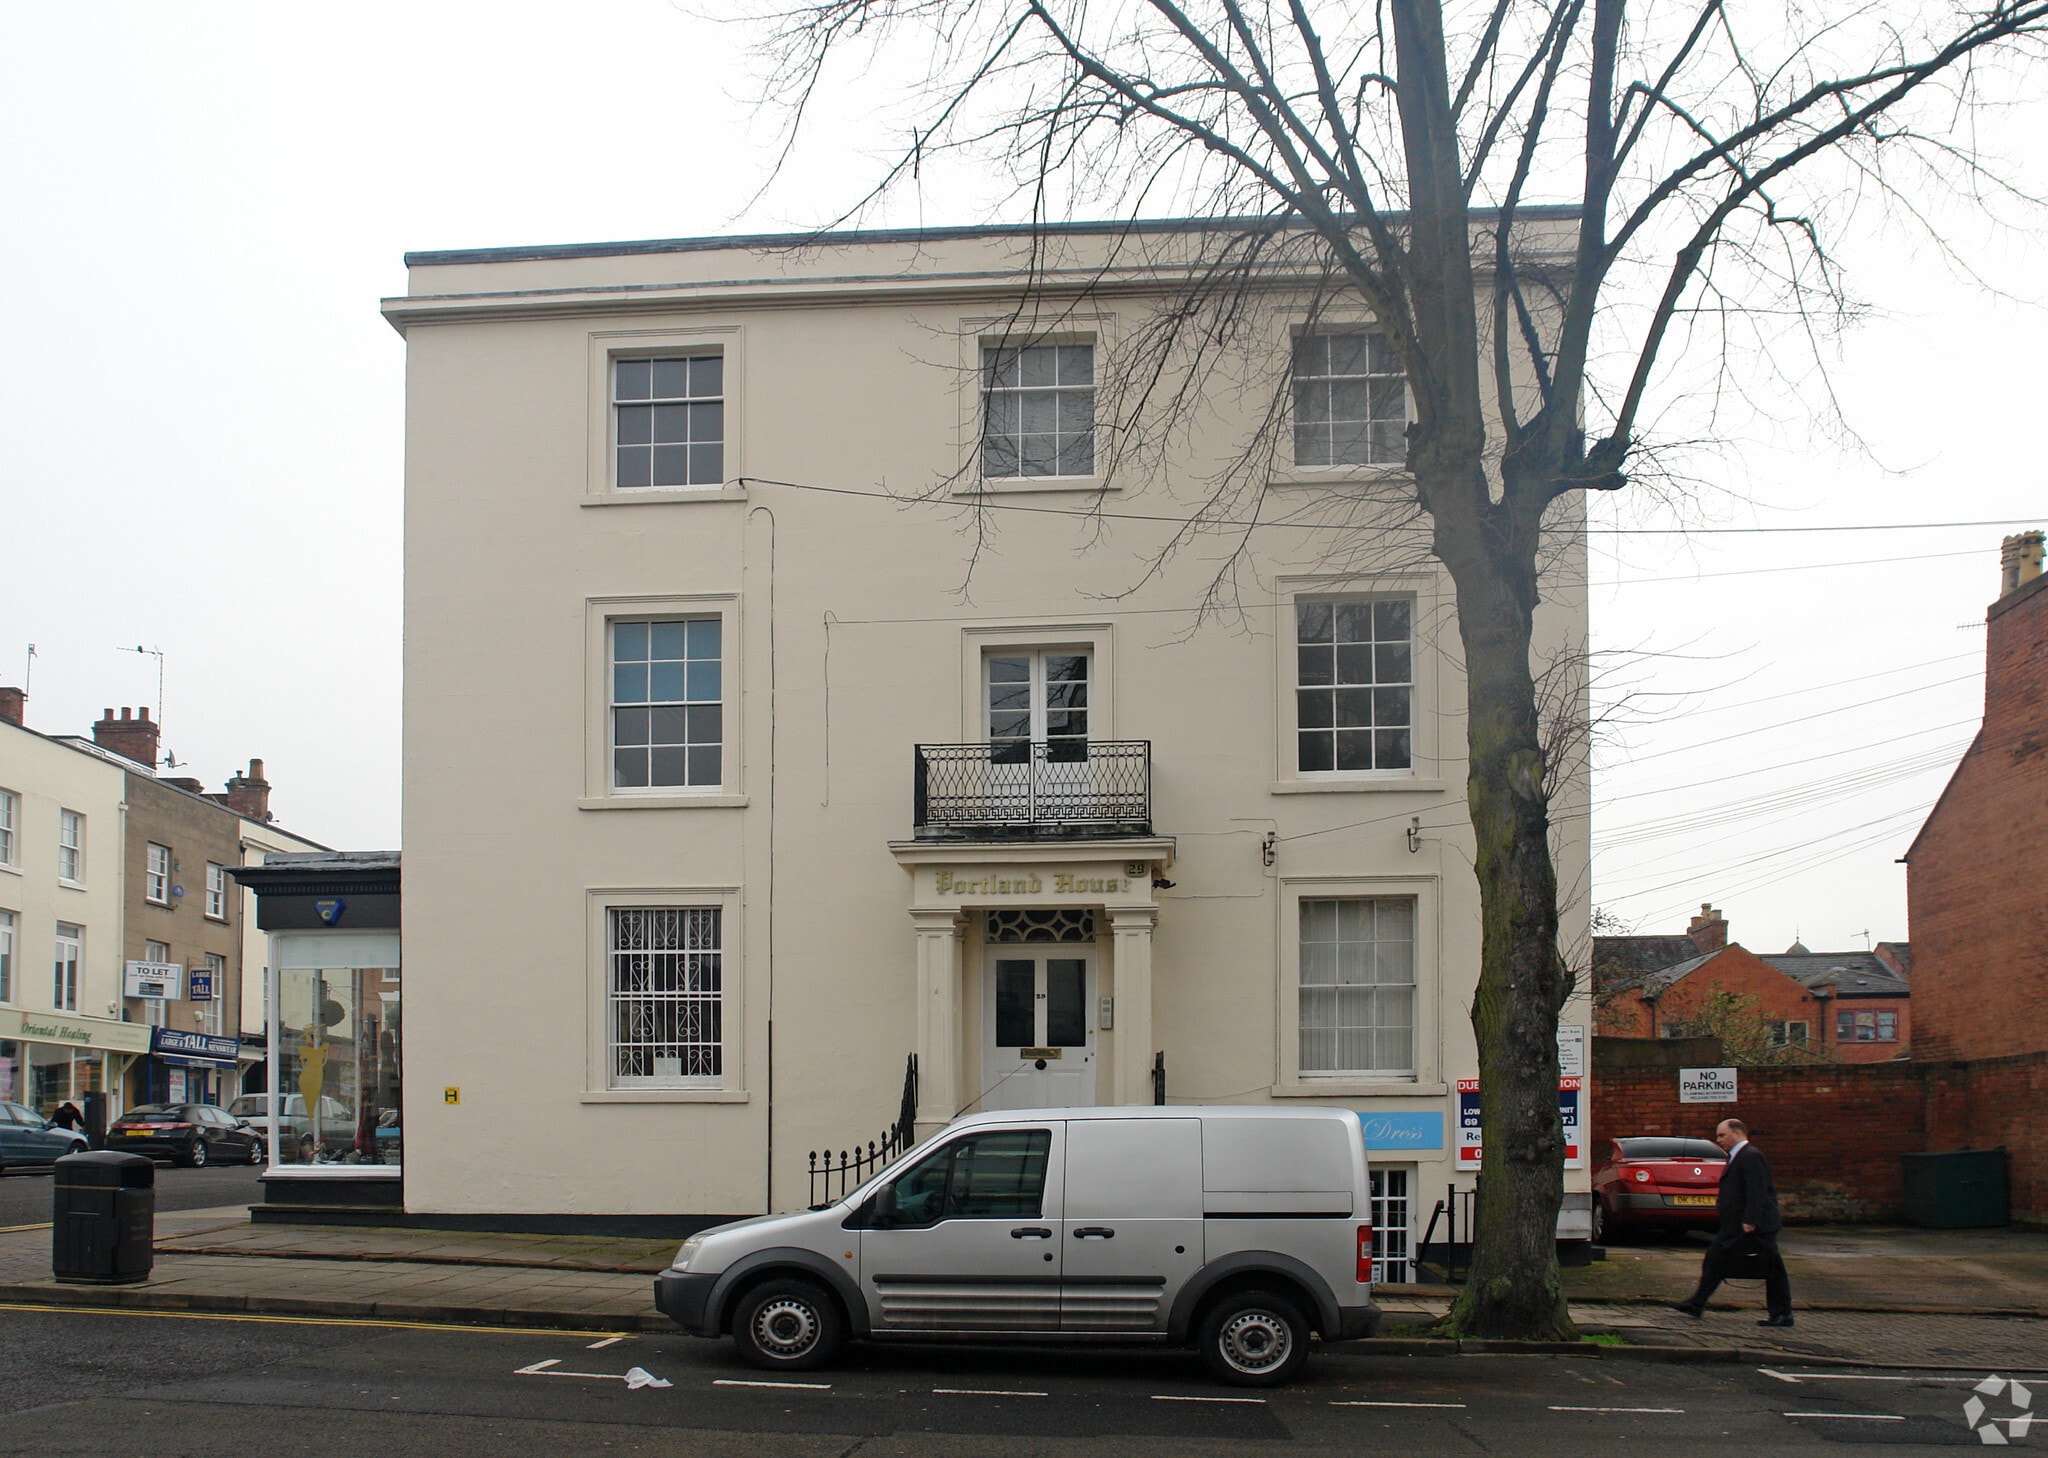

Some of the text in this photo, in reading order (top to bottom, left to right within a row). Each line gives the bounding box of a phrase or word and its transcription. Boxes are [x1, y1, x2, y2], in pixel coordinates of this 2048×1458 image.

[1128, 863, 1145, 875] 29
[935, 871, 1133, 896] Portland House
[137, 967, 170, 976] TO LET
[191, 984, 210, 994] TALL
[21, 1022, 57, 1037] Oriental
[59, 1026, 92, 1044] Healing
[161, 1037, 179, 1047] LARGE
[183, 1034, 208, 1051] TALL
[208, 1043, 237, 1054] MENSWEAR
[1700, 1071, 1717, 1080] NO
[1560, 1079, 1581, 1088] ION
[1683, 1081, 1734, 1090] PARKING
[445, 1090, 457, 1101] H
[1464, 1116, 1575, 1126] 69 T.)
[1363, 1118, 1423, 1140] Dress
